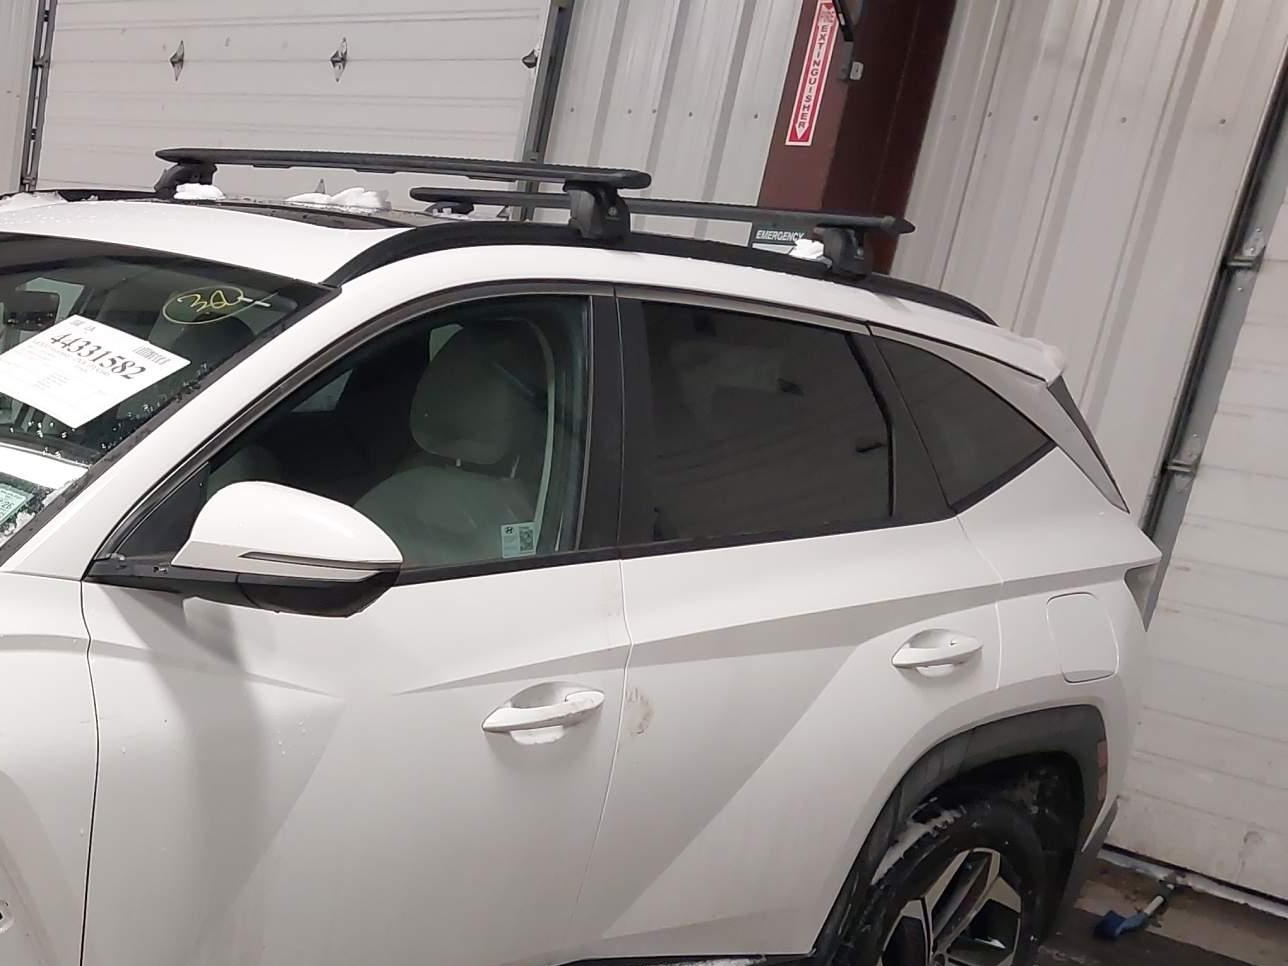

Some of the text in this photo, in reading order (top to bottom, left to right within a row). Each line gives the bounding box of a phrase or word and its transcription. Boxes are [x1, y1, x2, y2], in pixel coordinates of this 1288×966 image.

[798, 24, 828, 129] EXTINGUISHER
[755, 230, 805, 241] EMERGENCY
[50, 333, 146, 379] 44331582
